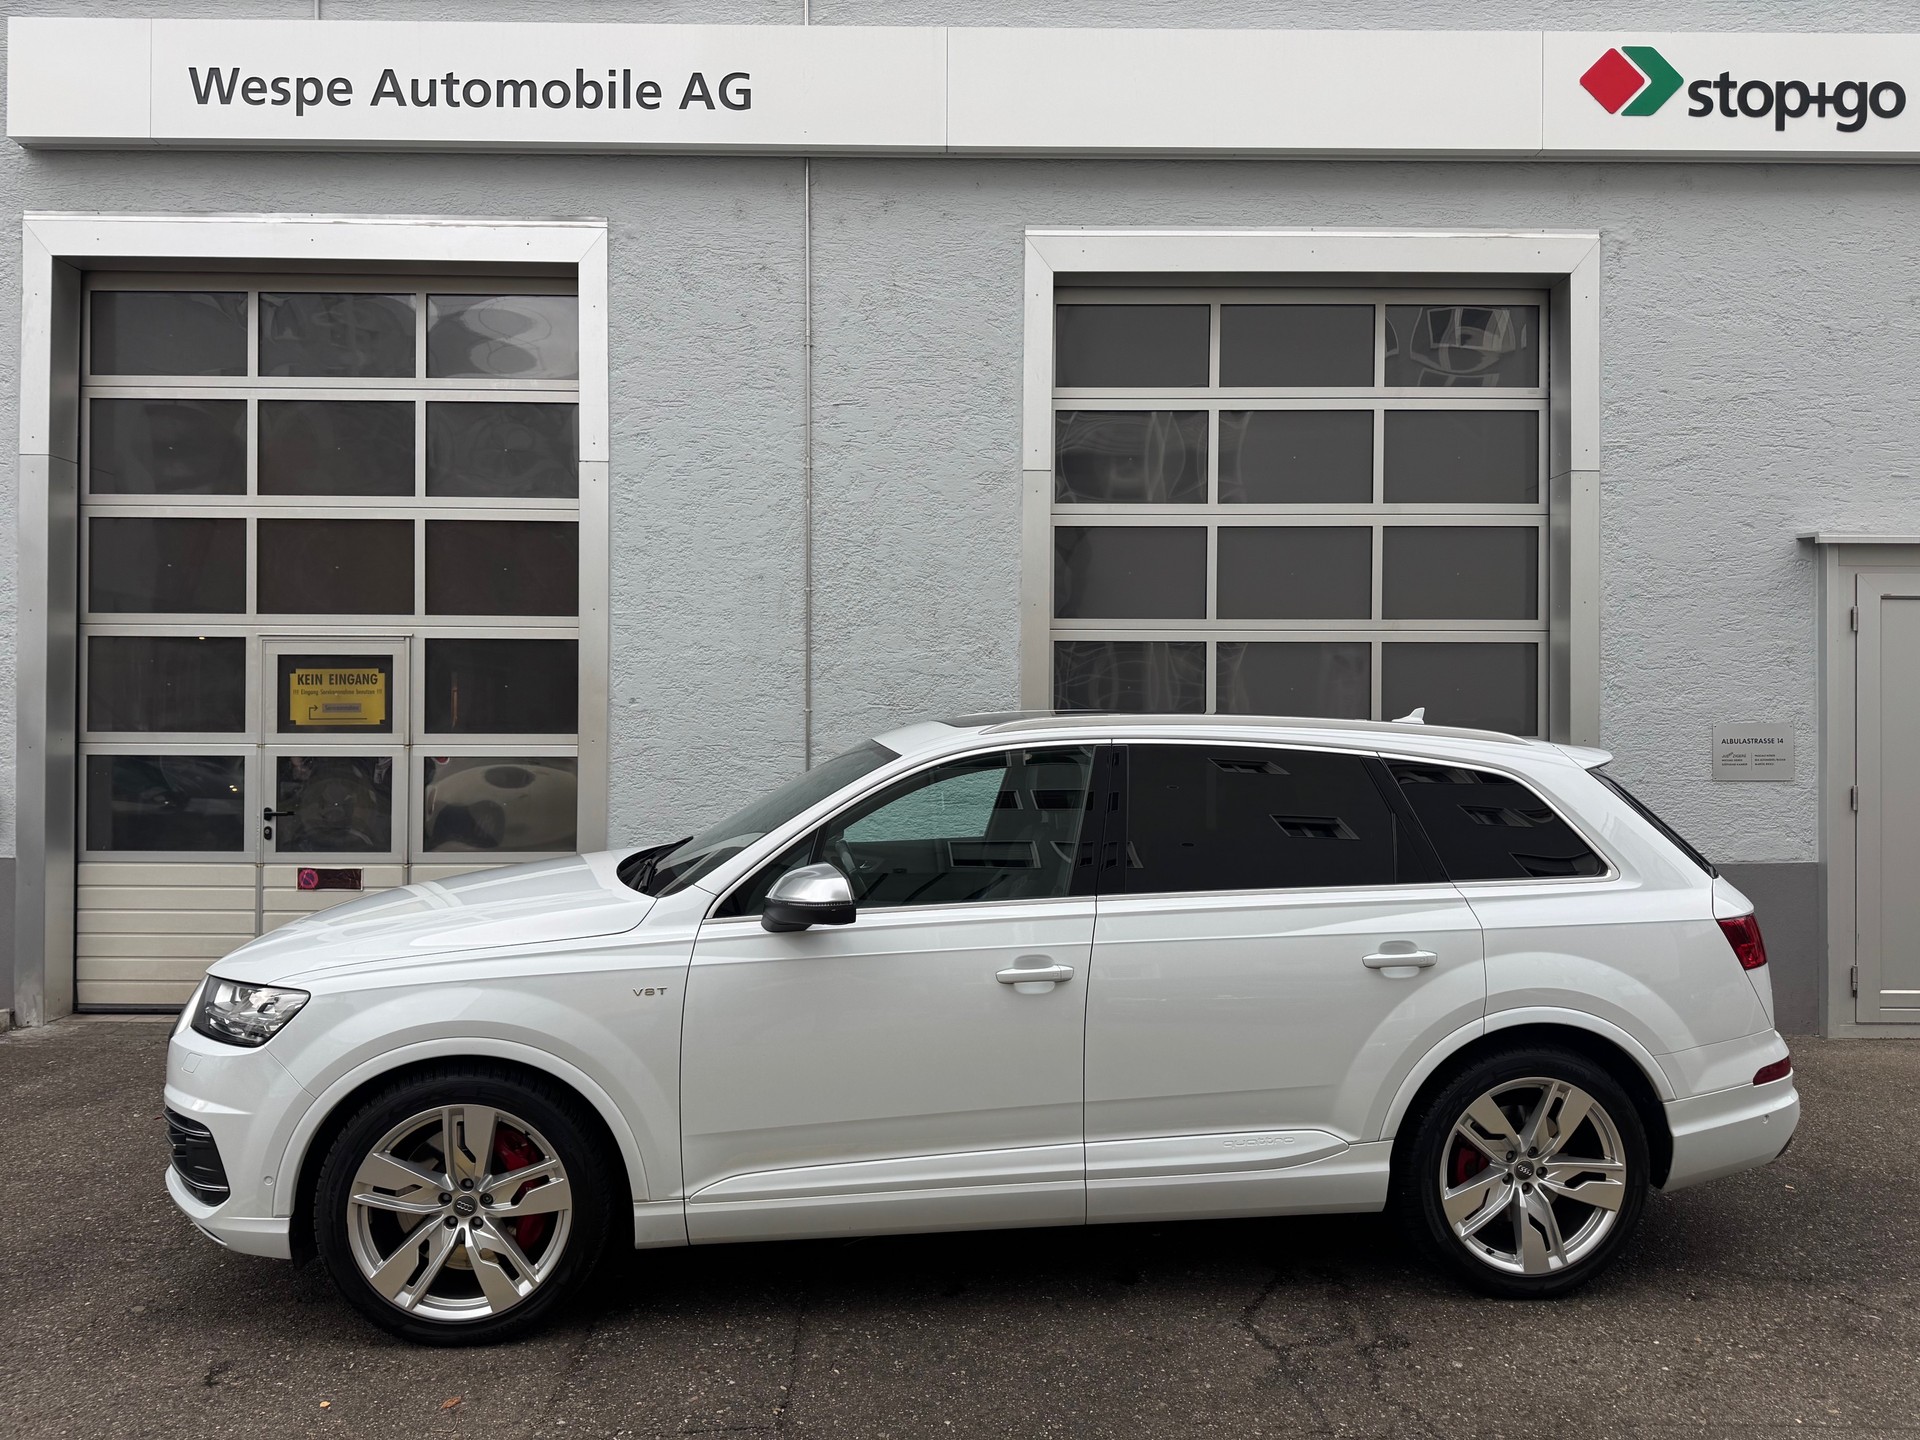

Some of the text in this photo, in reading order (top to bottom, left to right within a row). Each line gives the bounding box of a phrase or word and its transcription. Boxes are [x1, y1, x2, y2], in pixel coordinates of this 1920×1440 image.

[188, 66, 752, 117] Wespe Automobile AG
[1687, 71, 1907, 133] stop+go
[297, 673, 378, 686] KEIN EINGANG
[300, 688, 319, 696] Eingang
[1721, 737, 1775, 745] ALBULASTRASSE
[632, 986, 668, 997] V8T
[1223, 1136, 1295, 1150] quattro
